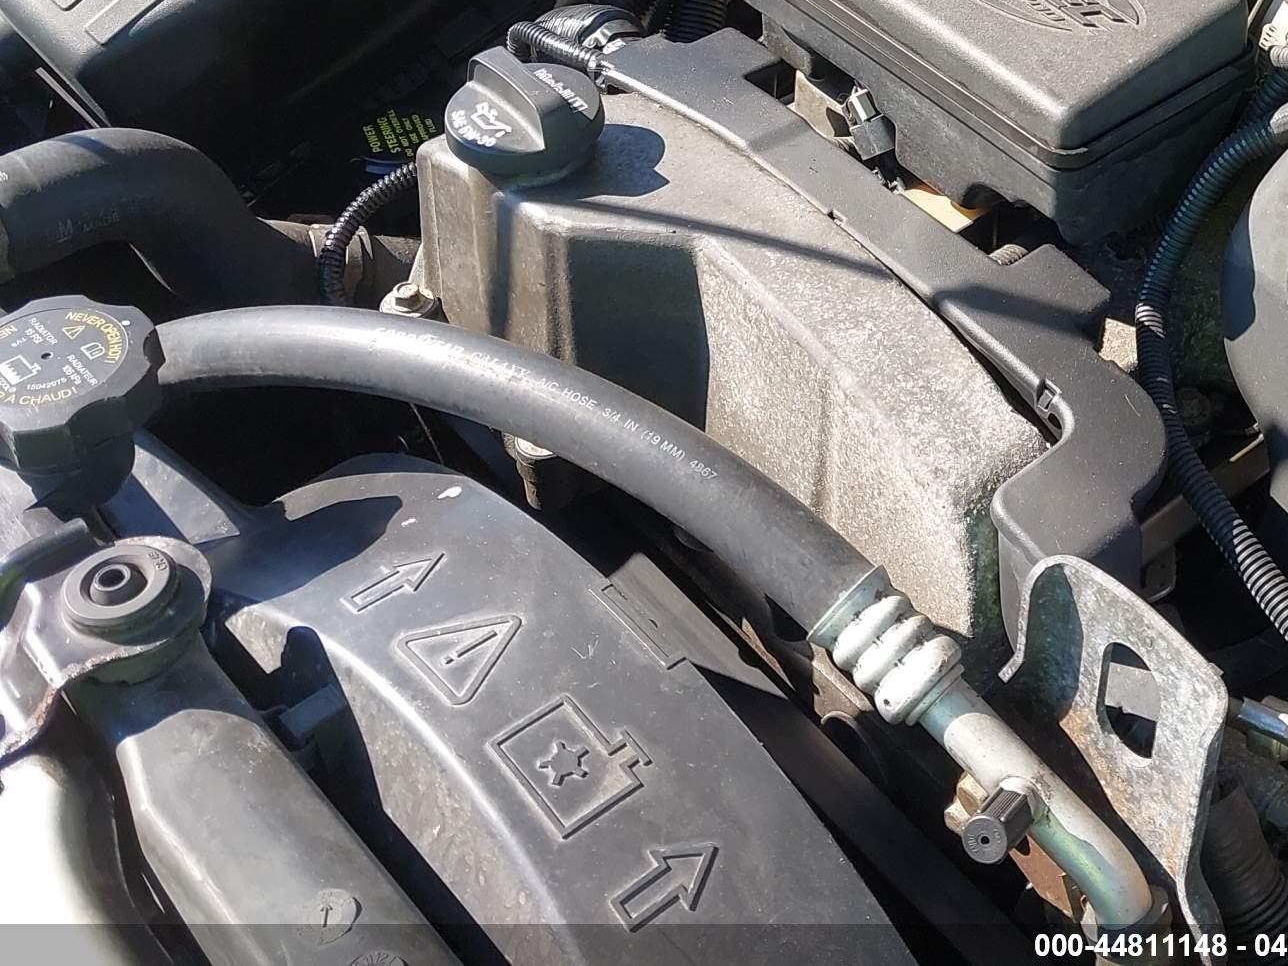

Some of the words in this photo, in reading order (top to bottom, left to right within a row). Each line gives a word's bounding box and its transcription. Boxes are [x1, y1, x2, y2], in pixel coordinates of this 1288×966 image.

[362, 124, 383, 153] POWER
[377, 116, 401, 153] STEERING
[458, 125, 496, 147] 5W-30
[65, 311, 105, 328] NEVER
[536, 377, 560, 392] A/C
[561, 387, 598, 411] HOSE
[601, 407, 620, 422] 3/4
[623, 418, 639, 433] IN
